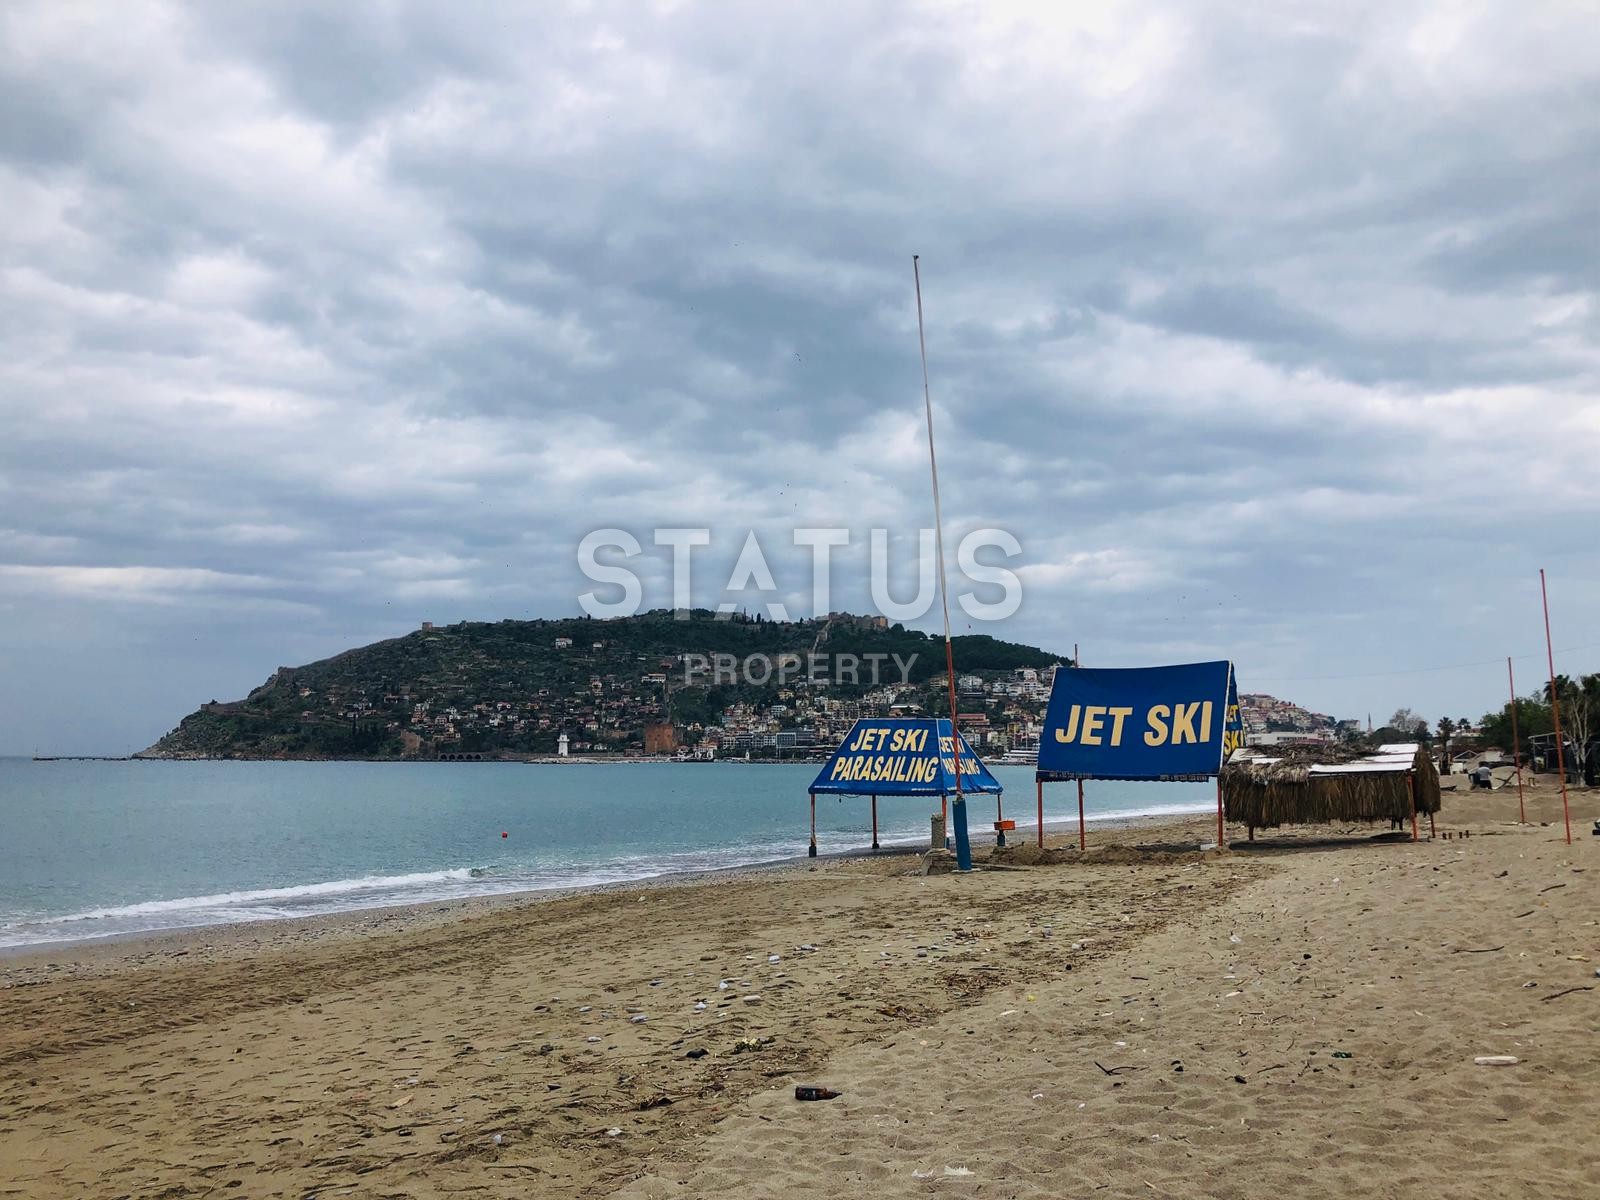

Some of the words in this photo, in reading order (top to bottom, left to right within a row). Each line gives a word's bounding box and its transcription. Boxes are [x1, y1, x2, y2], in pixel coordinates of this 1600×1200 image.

[1055, 705, 1133, 747] JET
[1144, 700, 1212, 747] SKI
[850, 728, 890, 752] JET
[889, 728, 929, 752] SKI
[830, 755, 939, 783] PARASAILING
